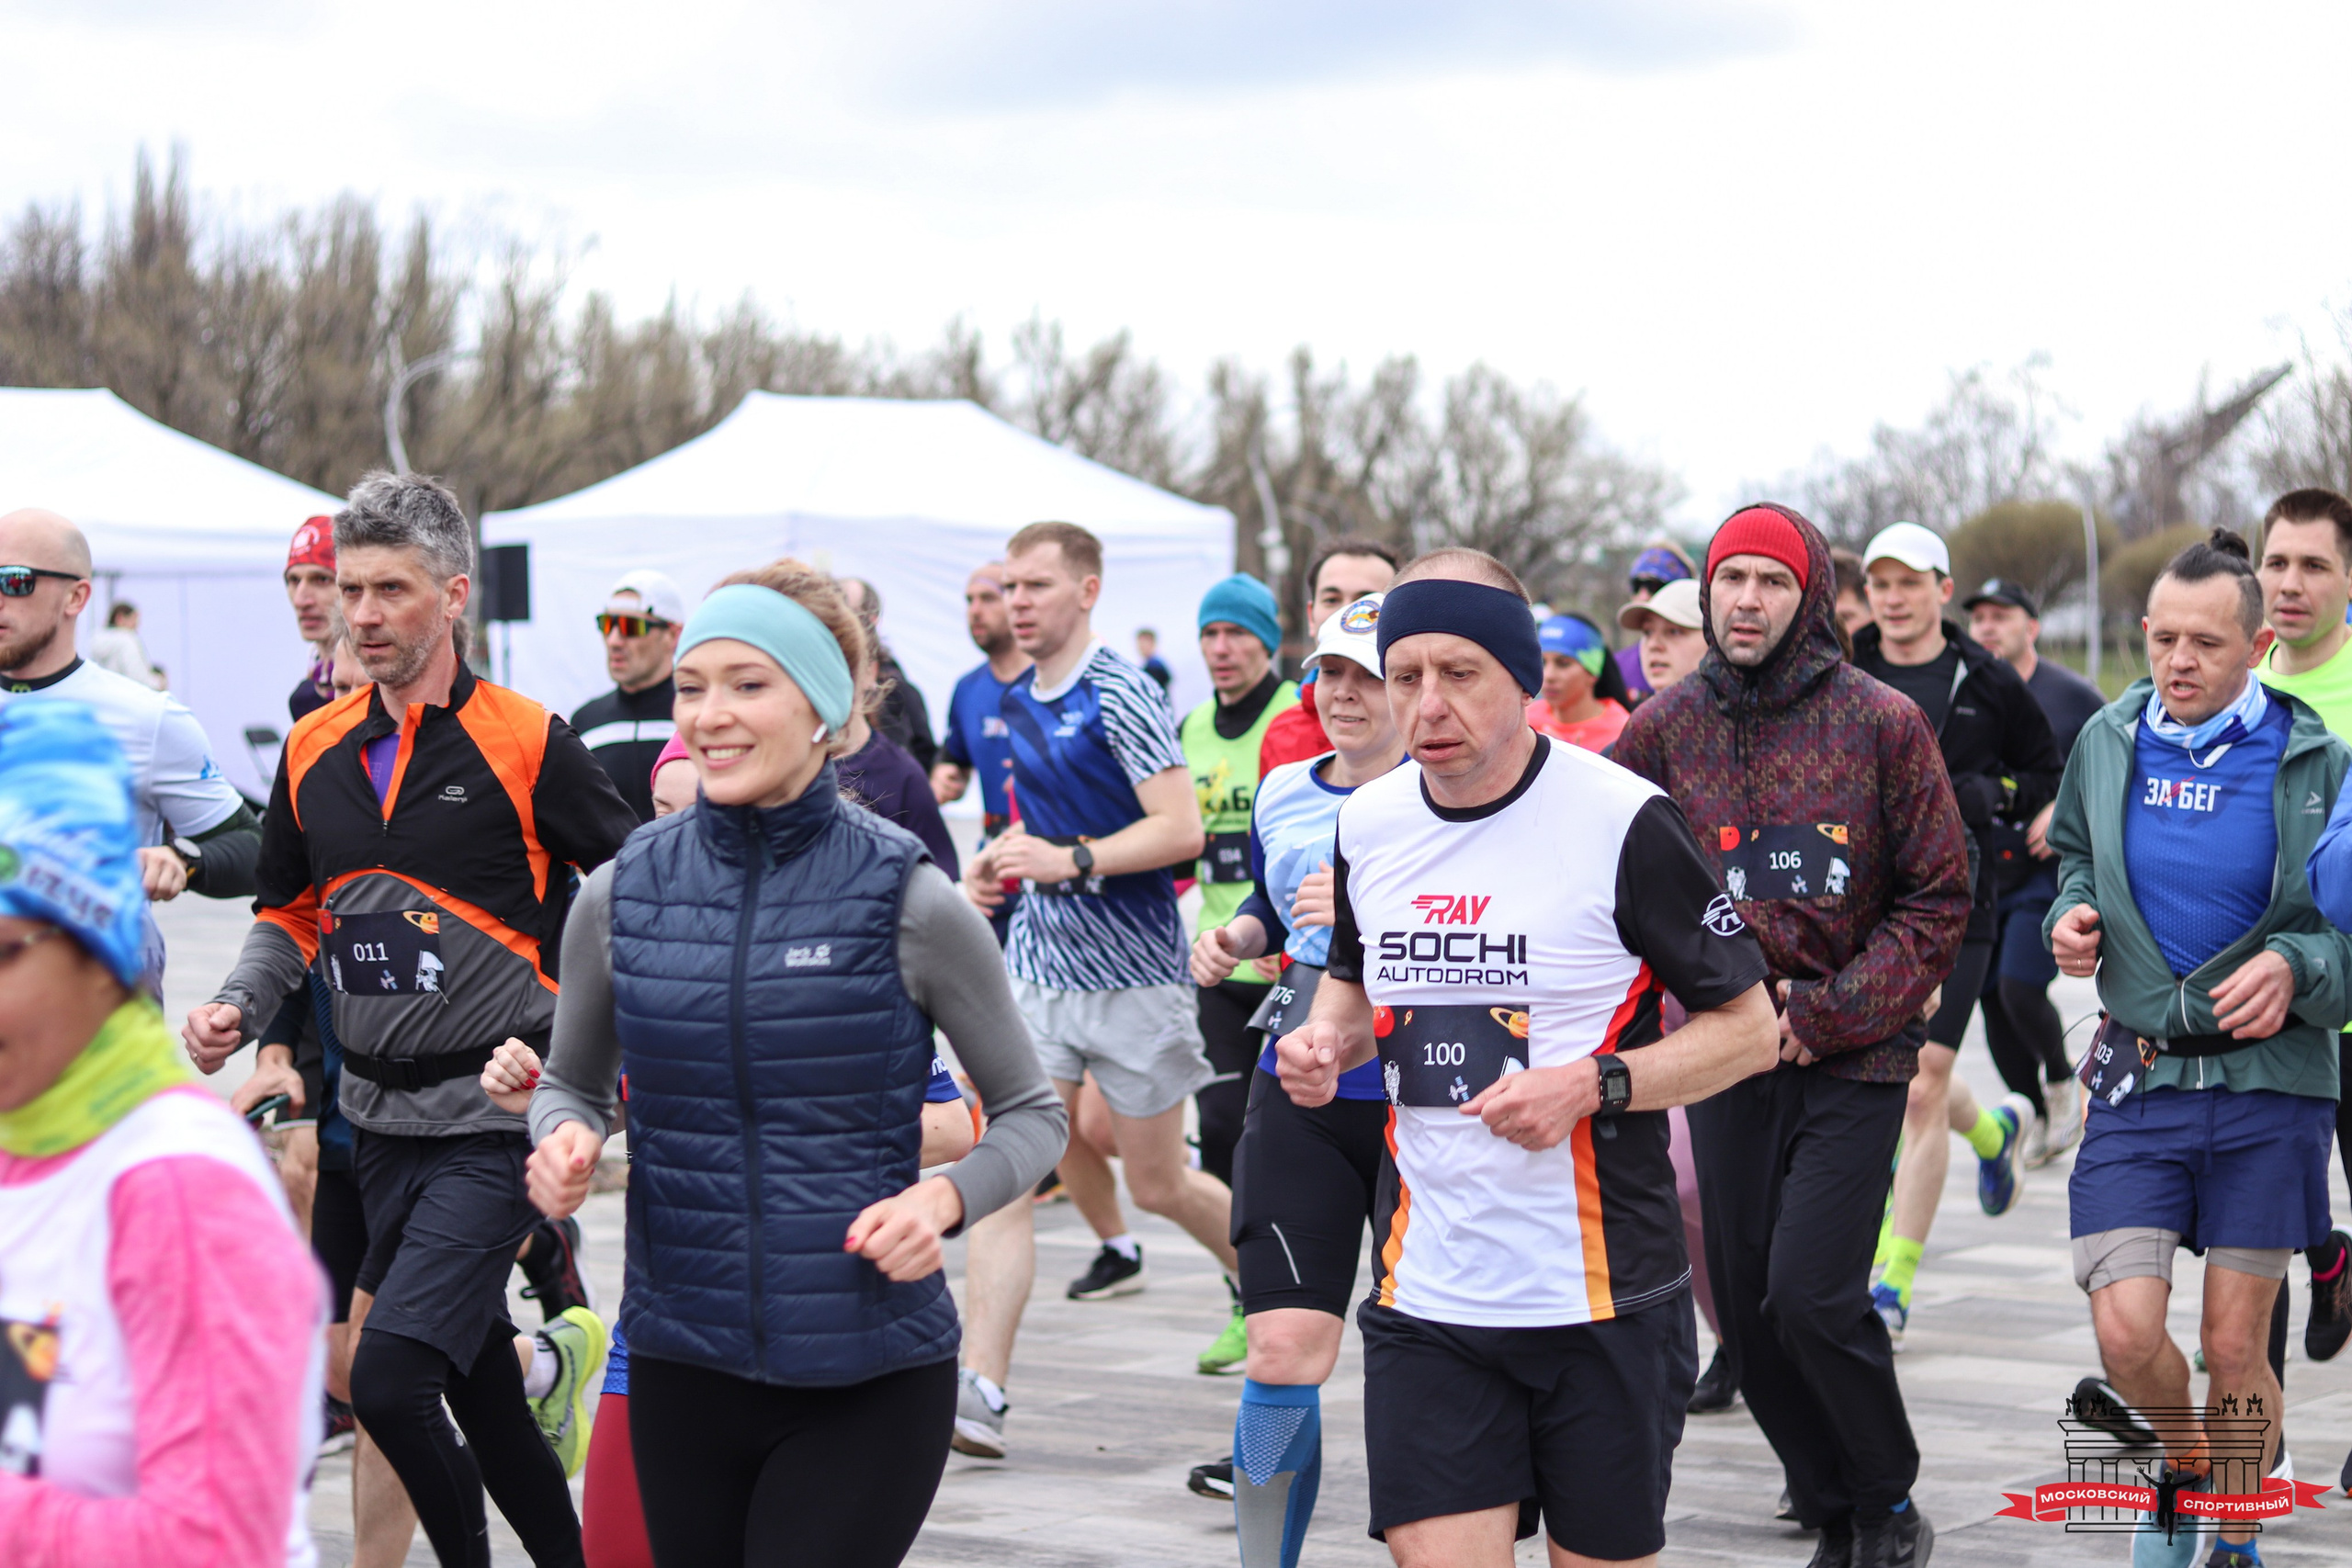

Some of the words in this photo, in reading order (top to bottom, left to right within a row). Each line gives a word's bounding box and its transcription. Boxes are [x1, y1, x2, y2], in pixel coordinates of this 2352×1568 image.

[1769, 851, 1802, 870] 106
[1410, 895, 1492, 925] RAY
[353, 942, 390, 962] 011
[1379, 931, 1527, 964] SOCHI
[1377, 965, 1529, 986] AUTODROM
[1269, 986, 1295, 1006] 076
[1423, 1042, 1466, 1066] 100
[2094, 1040, 2114, 1066] 103
